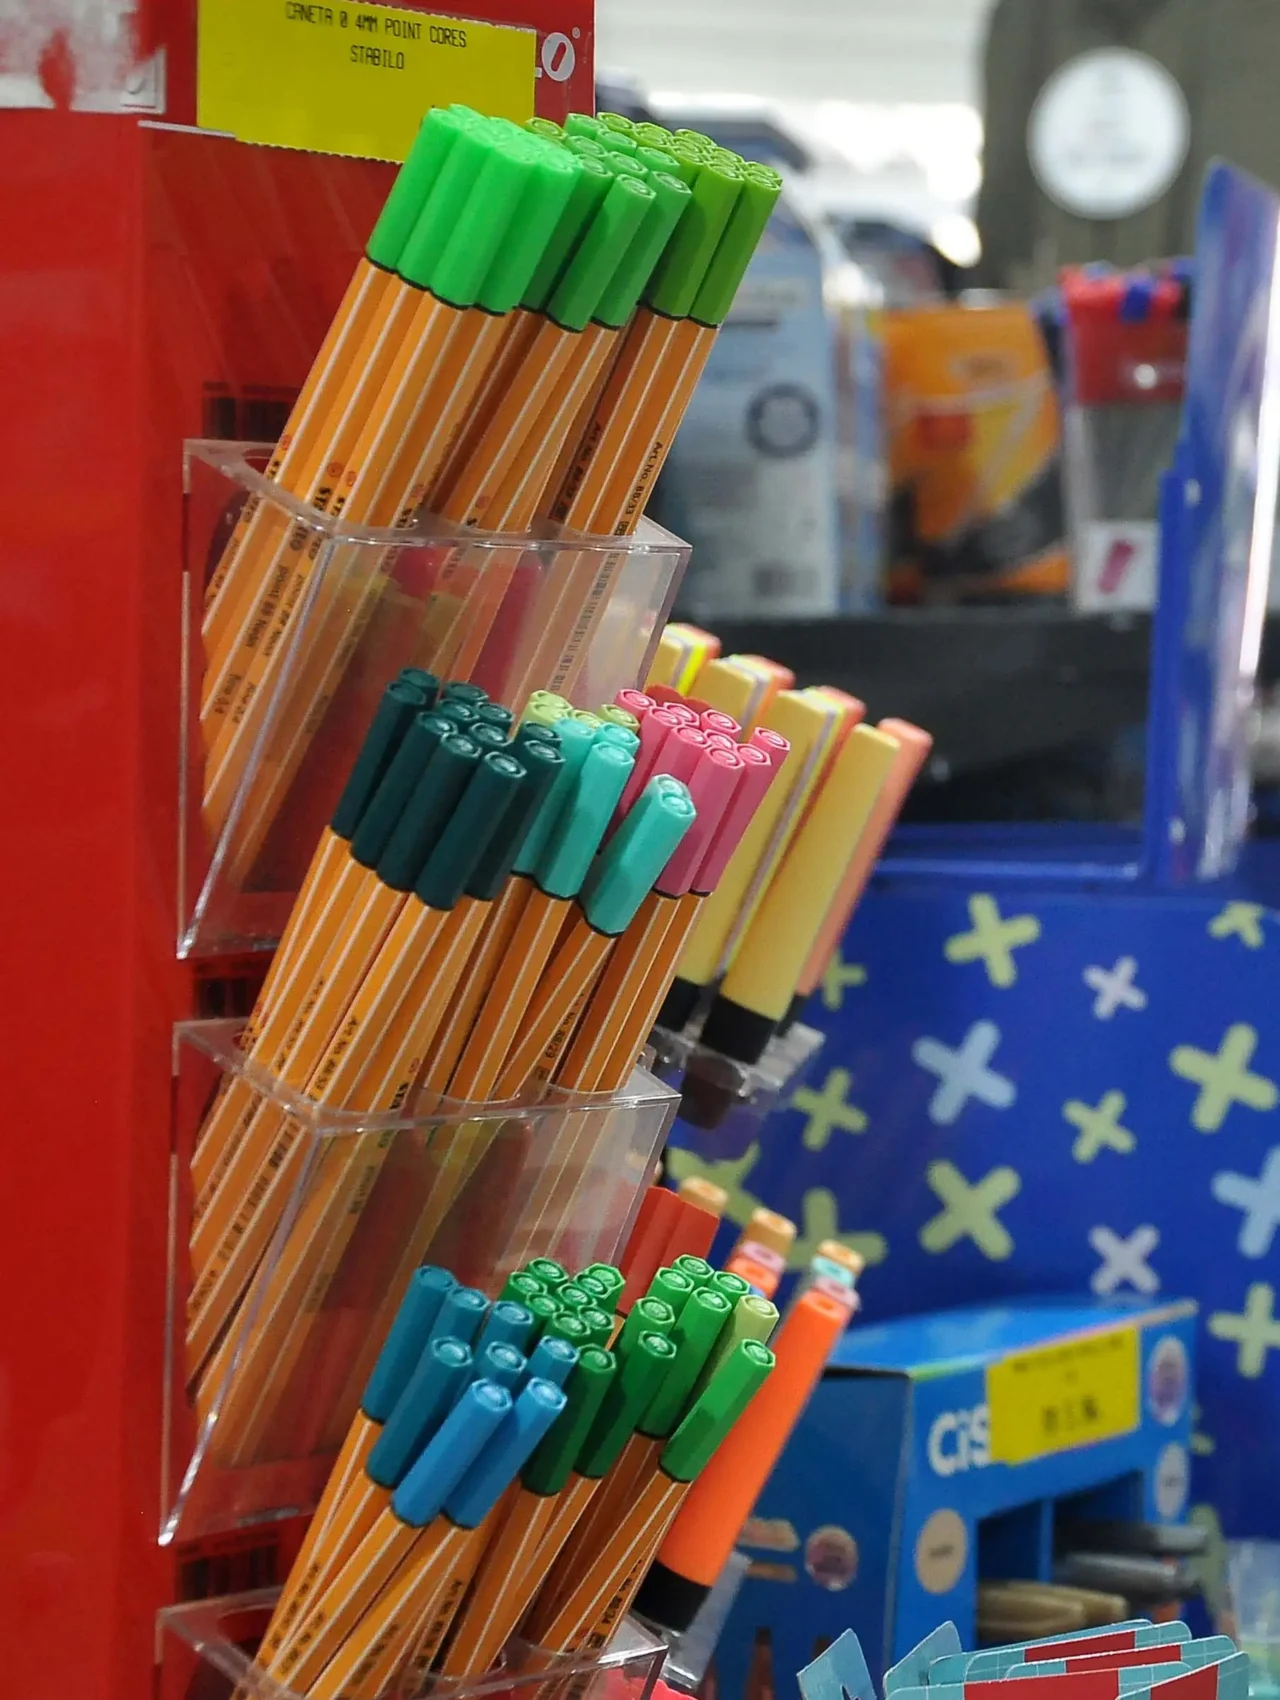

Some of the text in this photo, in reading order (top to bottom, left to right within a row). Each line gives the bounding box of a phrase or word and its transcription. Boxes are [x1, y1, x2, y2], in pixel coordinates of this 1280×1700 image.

[286, 1, 333, 26] CANETA
[355, 14, 378, 33] 4MM
[384, 18, 421, 40] POINT
[429, 25, 467, 48] CORES
[350, 44, 405, 70] STABILO
